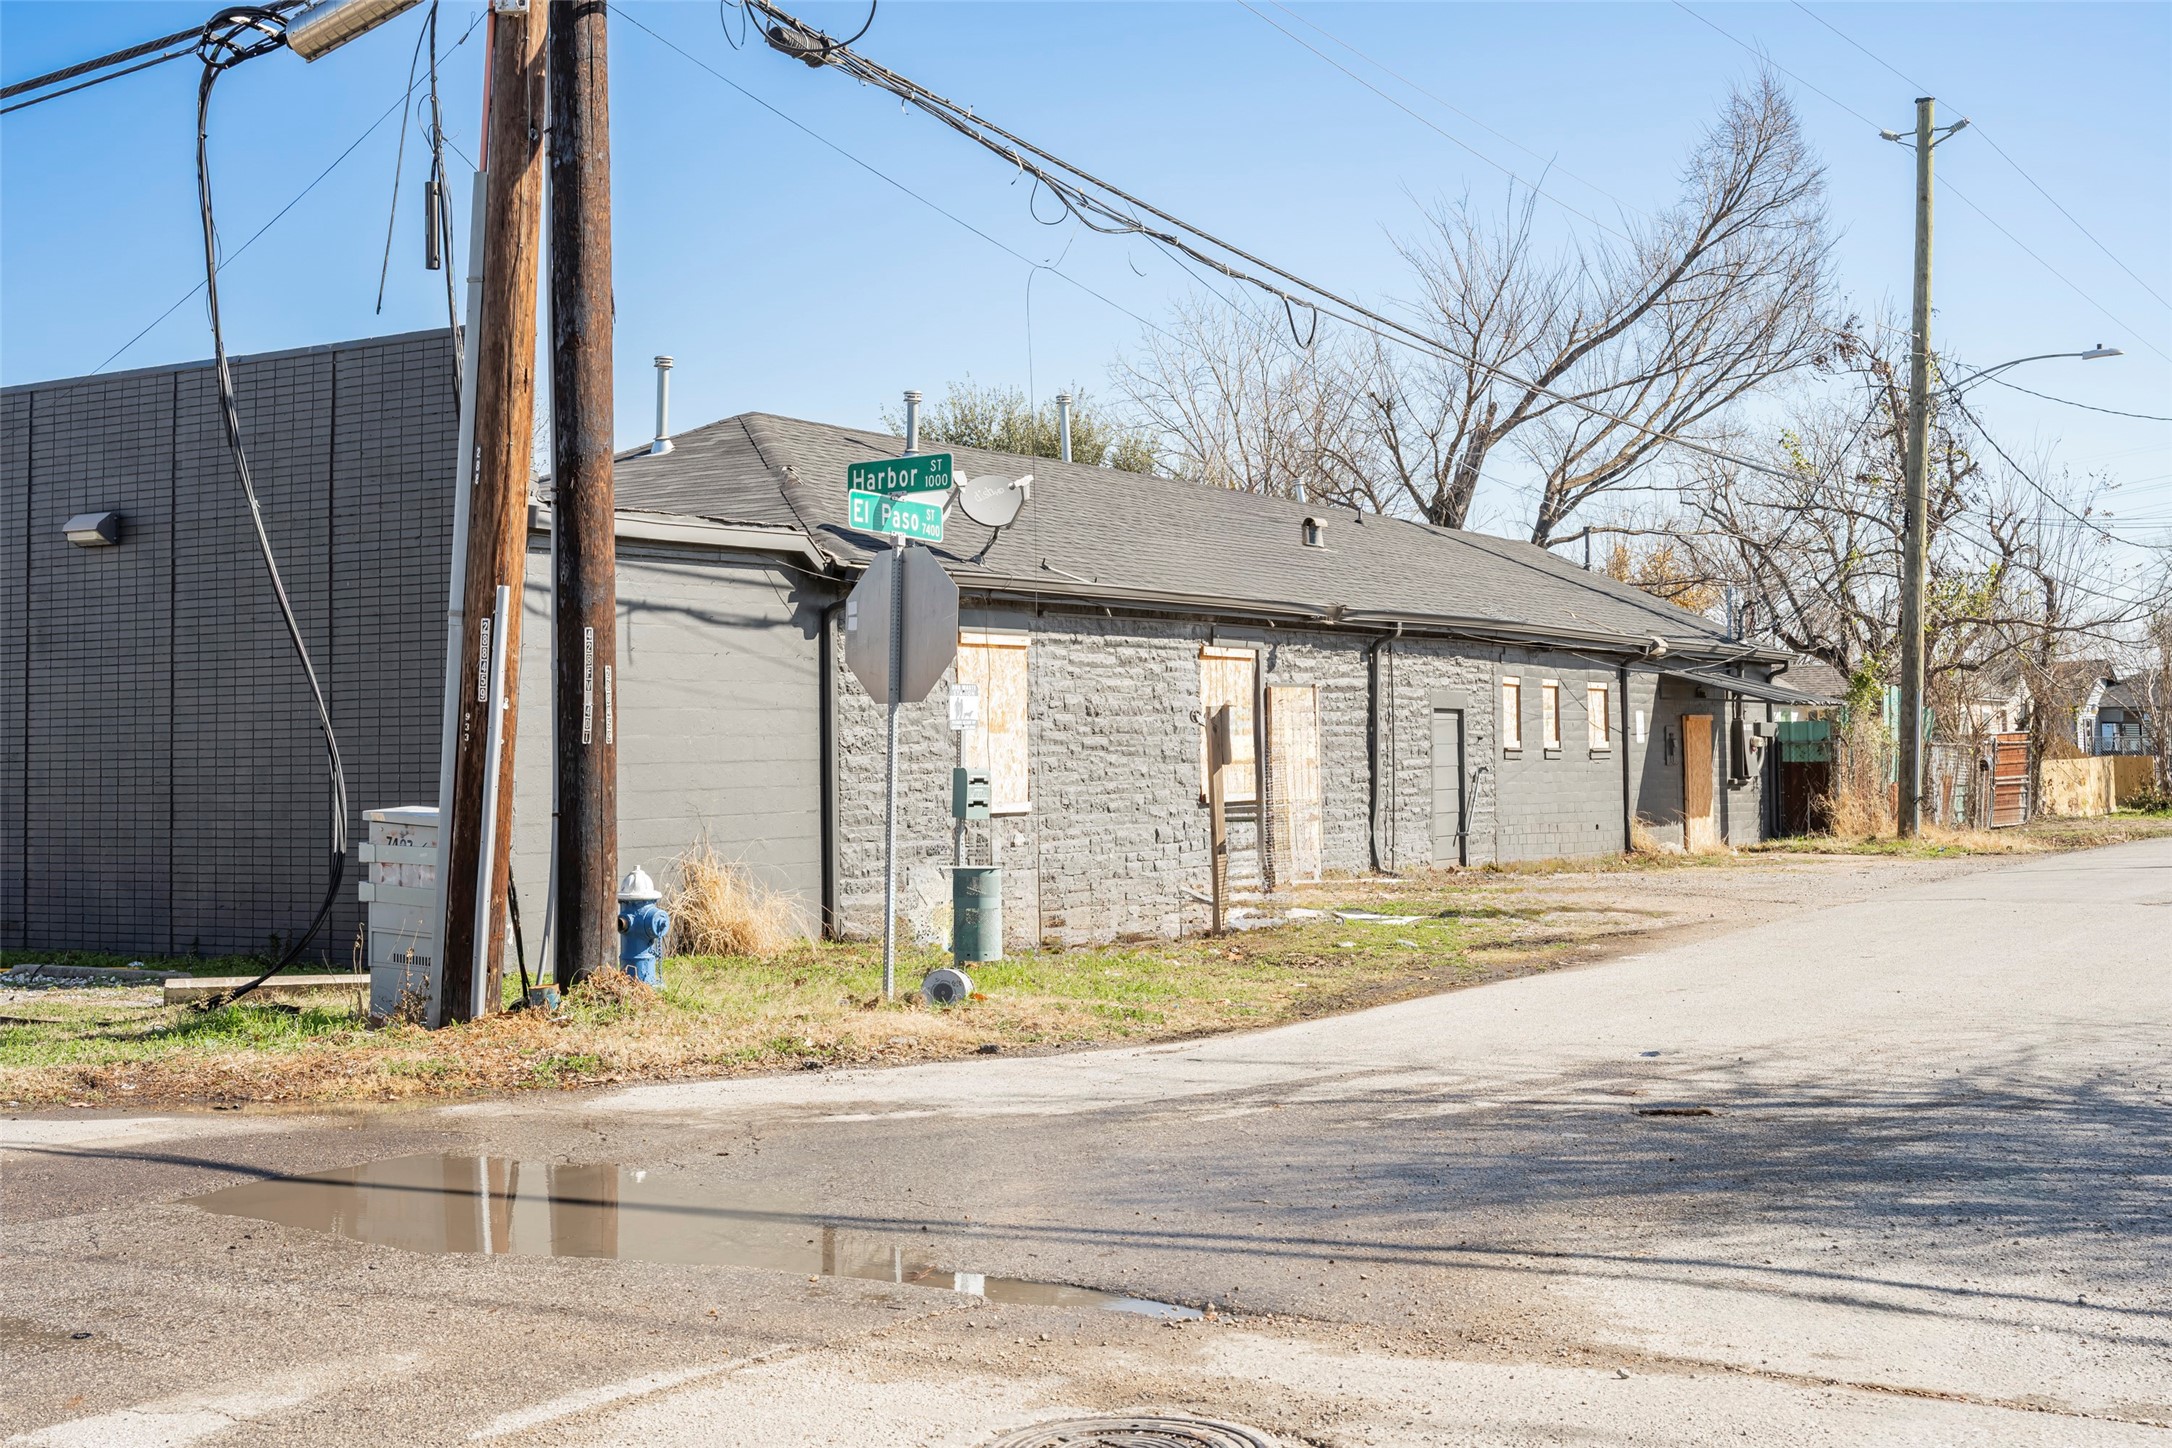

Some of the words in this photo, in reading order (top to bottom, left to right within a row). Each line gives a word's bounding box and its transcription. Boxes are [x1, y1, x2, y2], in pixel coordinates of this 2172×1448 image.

[853, 466, 918, 490] Harbor
[930, 459, 943, 472] ST
[925, 473, 948, 488] 1000
[853, 498, 869, 523] El
[881, 503, 919, 531] Paso
[926, 509, 935, 521] ST
[922, 522, 940, 537] 7400
[479, 619, 489, 701] 288459
